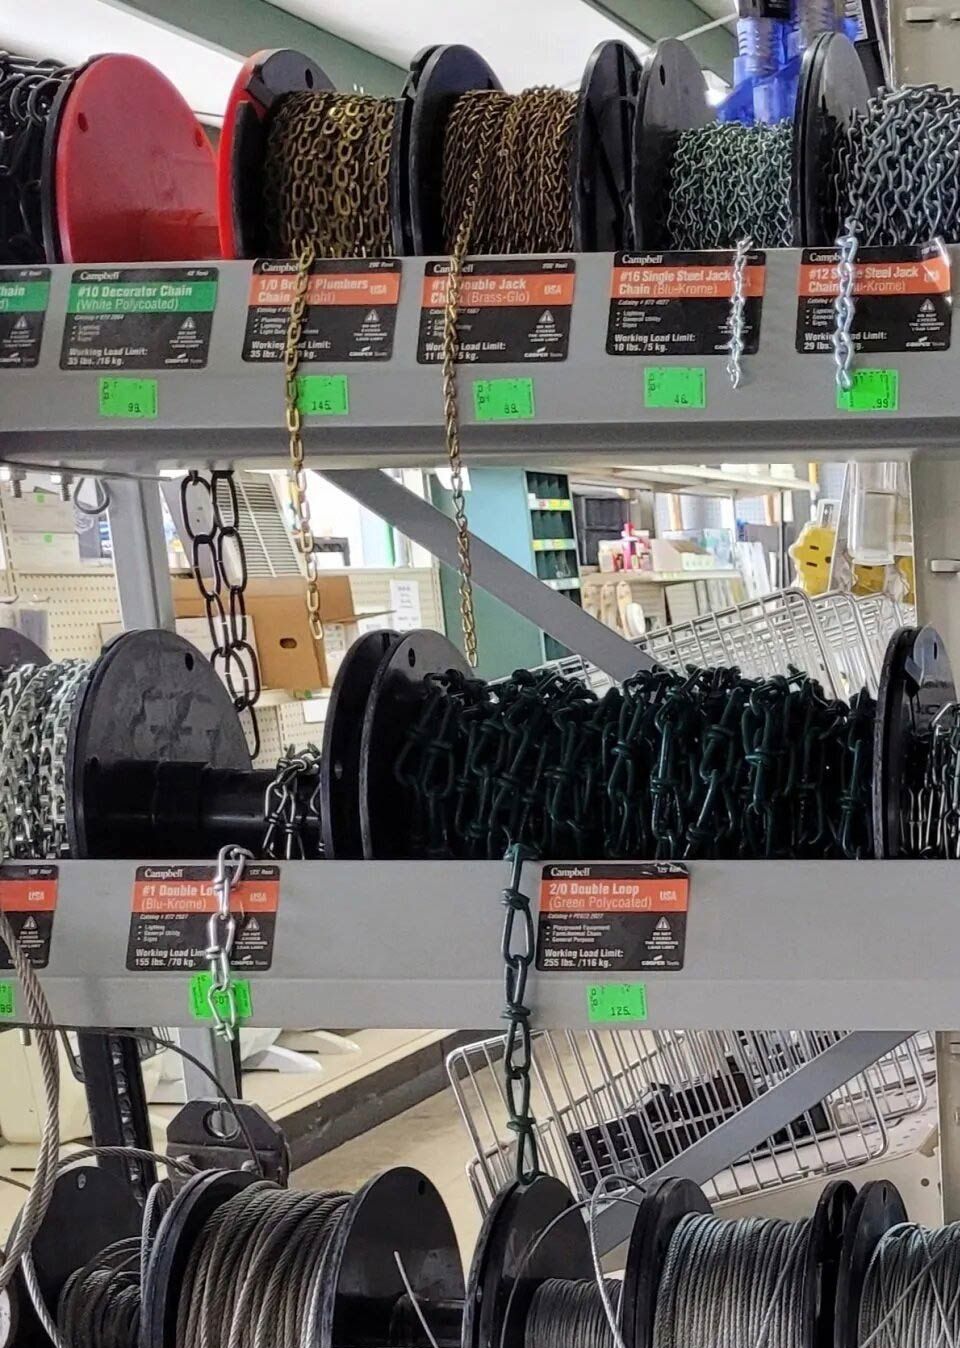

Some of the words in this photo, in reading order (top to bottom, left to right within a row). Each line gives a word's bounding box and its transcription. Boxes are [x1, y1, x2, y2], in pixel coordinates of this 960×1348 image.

[622, 255, 663, 266] Campbell
[80, 272, 119, 281] Campbell
[620, 272, 639, 281] #16
[642, 271, 674, 284] Single
[677, 271, 703, 281] Steel
[706, 270, 731, 280] Jack
[78, 286, 98, 296] #10
[102, 286, 156, 296] Decorator
[160, 286, 192, 296] Chain
[619, 284, 650, 295] Chain
[653, 283, 717, 295] (Blu-Krome)
[76, 300, 112, 311] (White
[115, 299, 178, 312] Polycoated)
[551, 868, 590, 878] Campbell
[550, 884, 567, 895] 2/0
[571, 884, 609, 895] Double
[613, 884, 639, 896] Loop
[660, 892, 677, 900] USA
[550, 897, 585, 909] (Green
[589, 897, 652, 909] Polycoated)
